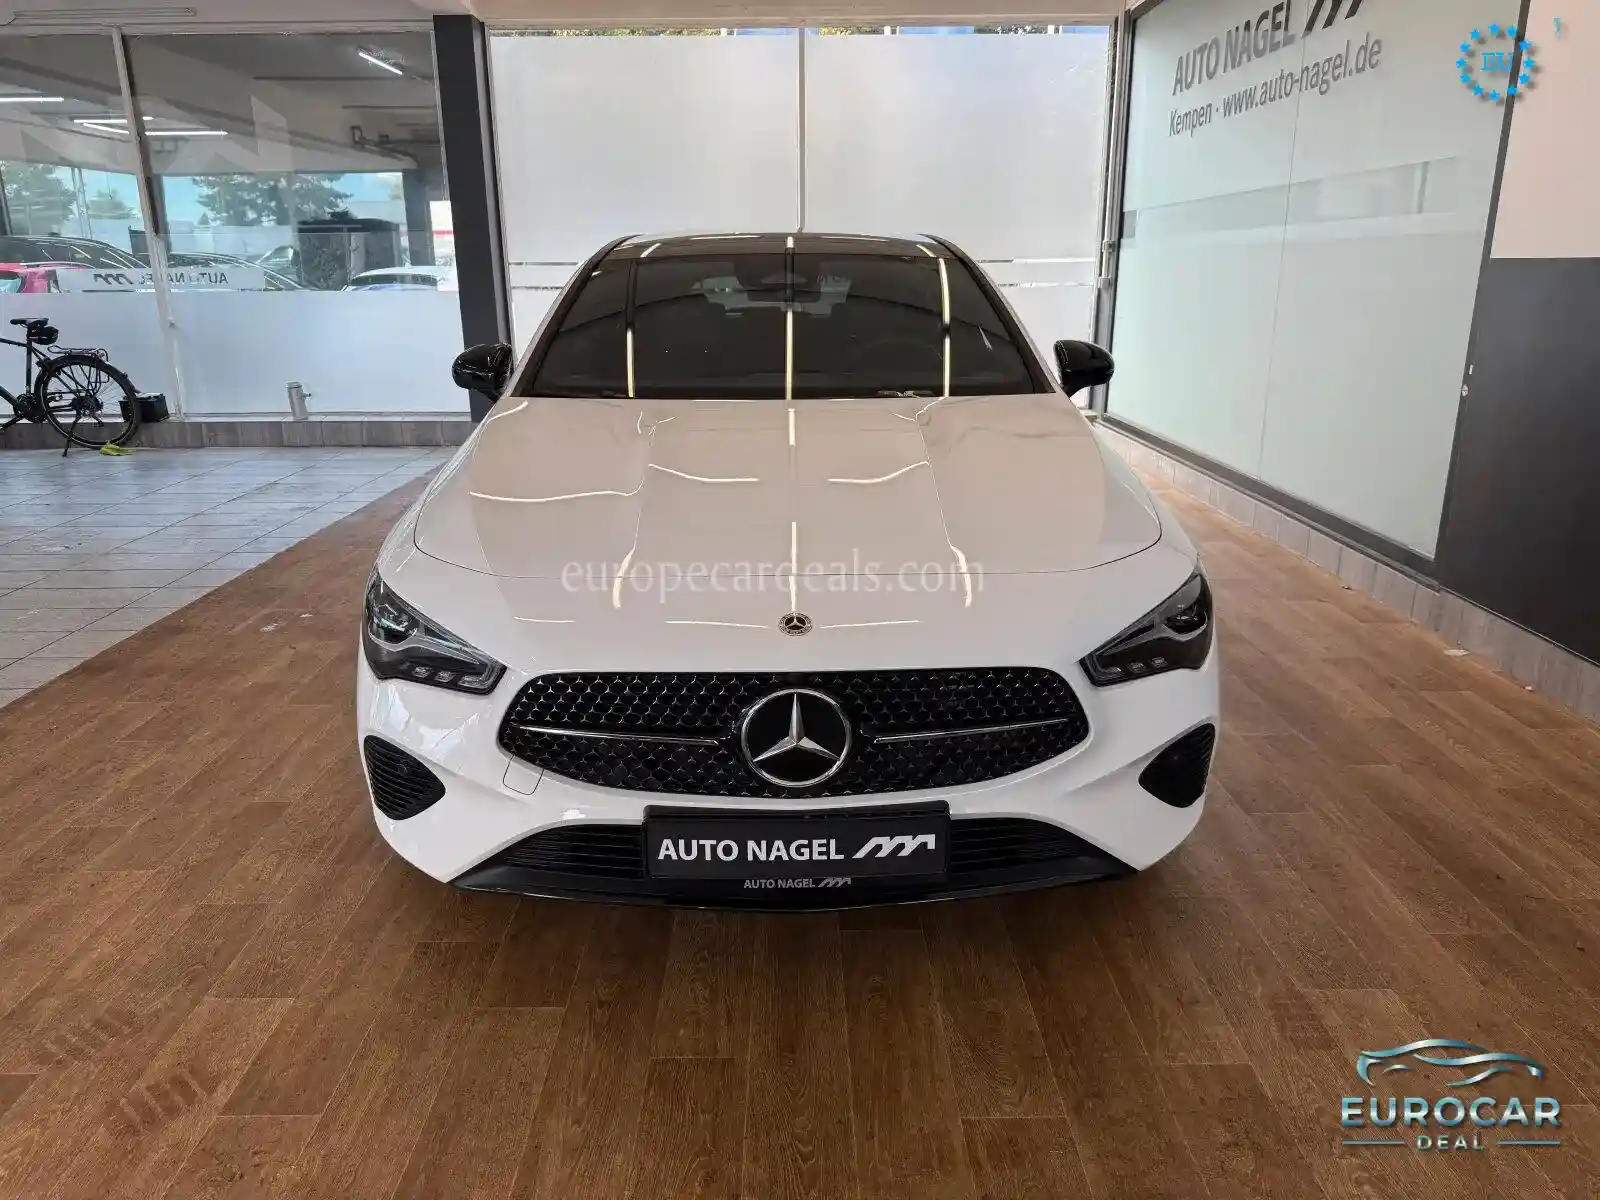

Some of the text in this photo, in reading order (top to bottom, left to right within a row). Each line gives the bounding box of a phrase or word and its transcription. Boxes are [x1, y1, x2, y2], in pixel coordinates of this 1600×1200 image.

[1172, 0, 1296, 96] AUTO NAGEL
[1169, 102, 1213, 137] Kempen
[1222, 32, 1382, 118] www.auto-nagel.de
[657, 838, 844, 861] AUTO NAGEL
[743, 878, 816, 889] AUTO NAGEL
